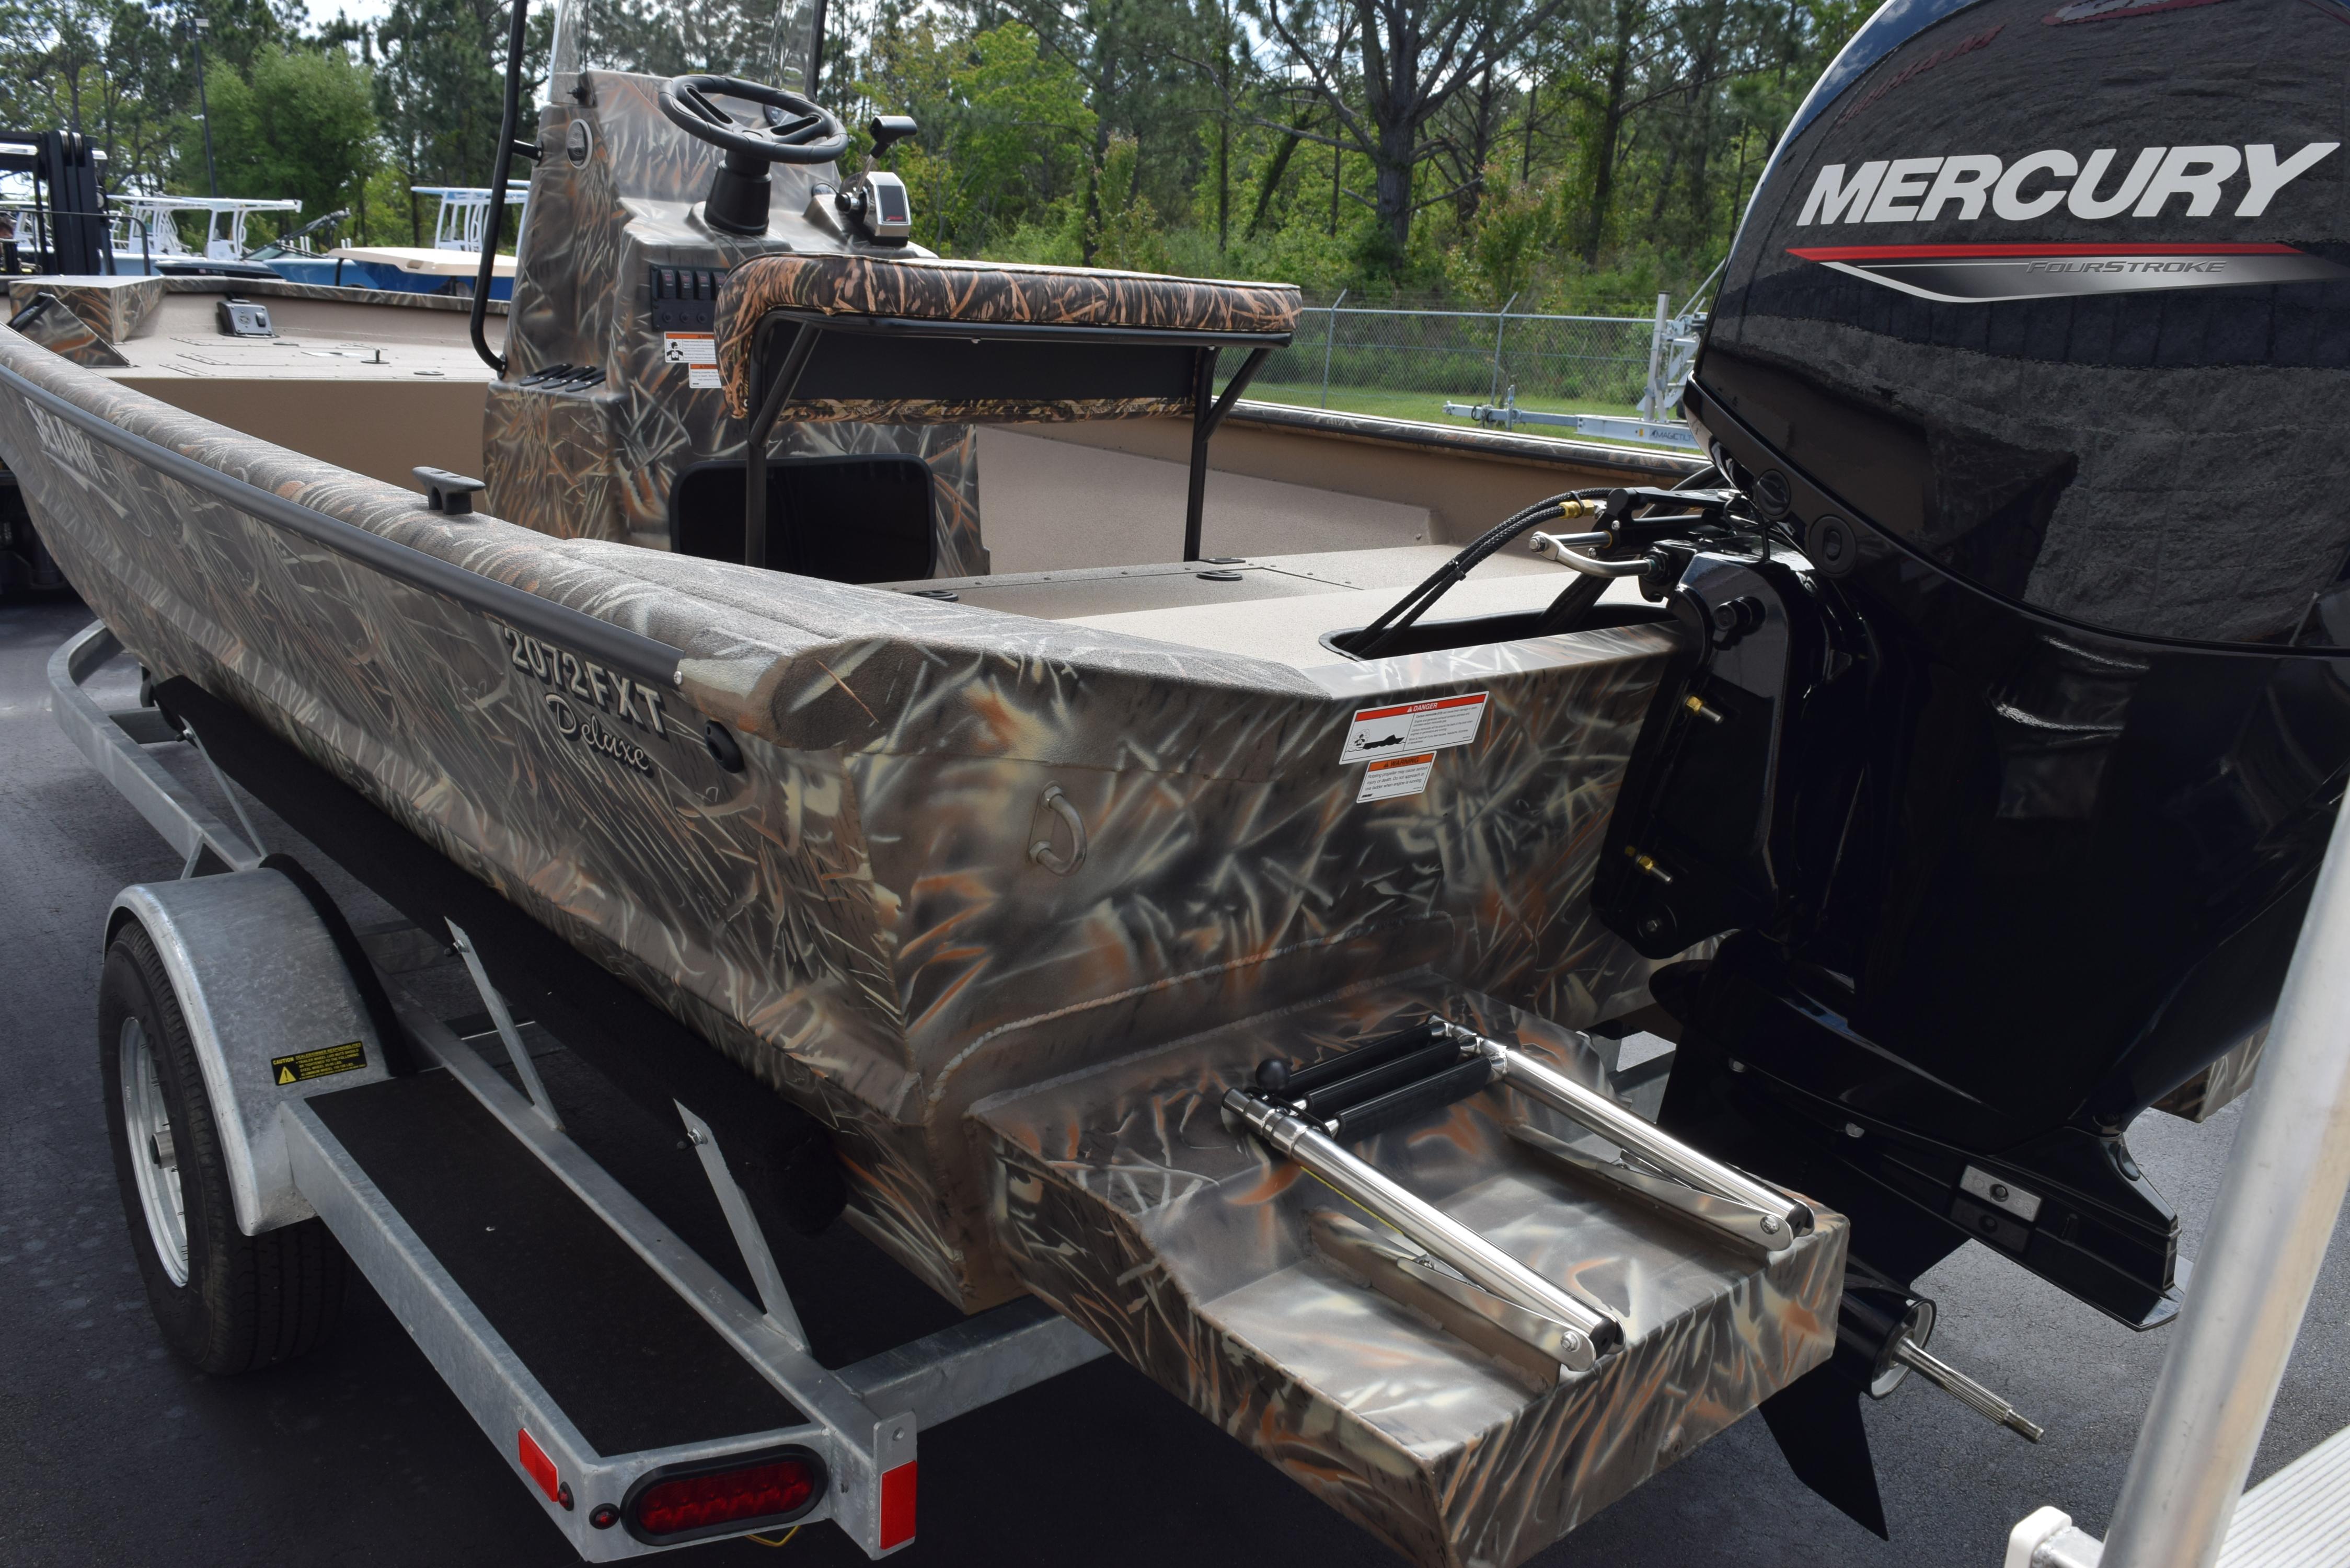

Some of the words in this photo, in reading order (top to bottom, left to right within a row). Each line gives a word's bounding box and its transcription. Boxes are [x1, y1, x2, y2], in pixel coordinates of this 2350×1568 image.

[1796, 142, 2341, 226] MERCURY
[504, 627, 667, 737] 2072FXT
[1413, 702, 1438, 712] DANGER
[545, 693, 653, 775] Deluxe
[1389, 756, 1420, 766] WARNING
[273, 1056, 293, 1065] CAUTION
